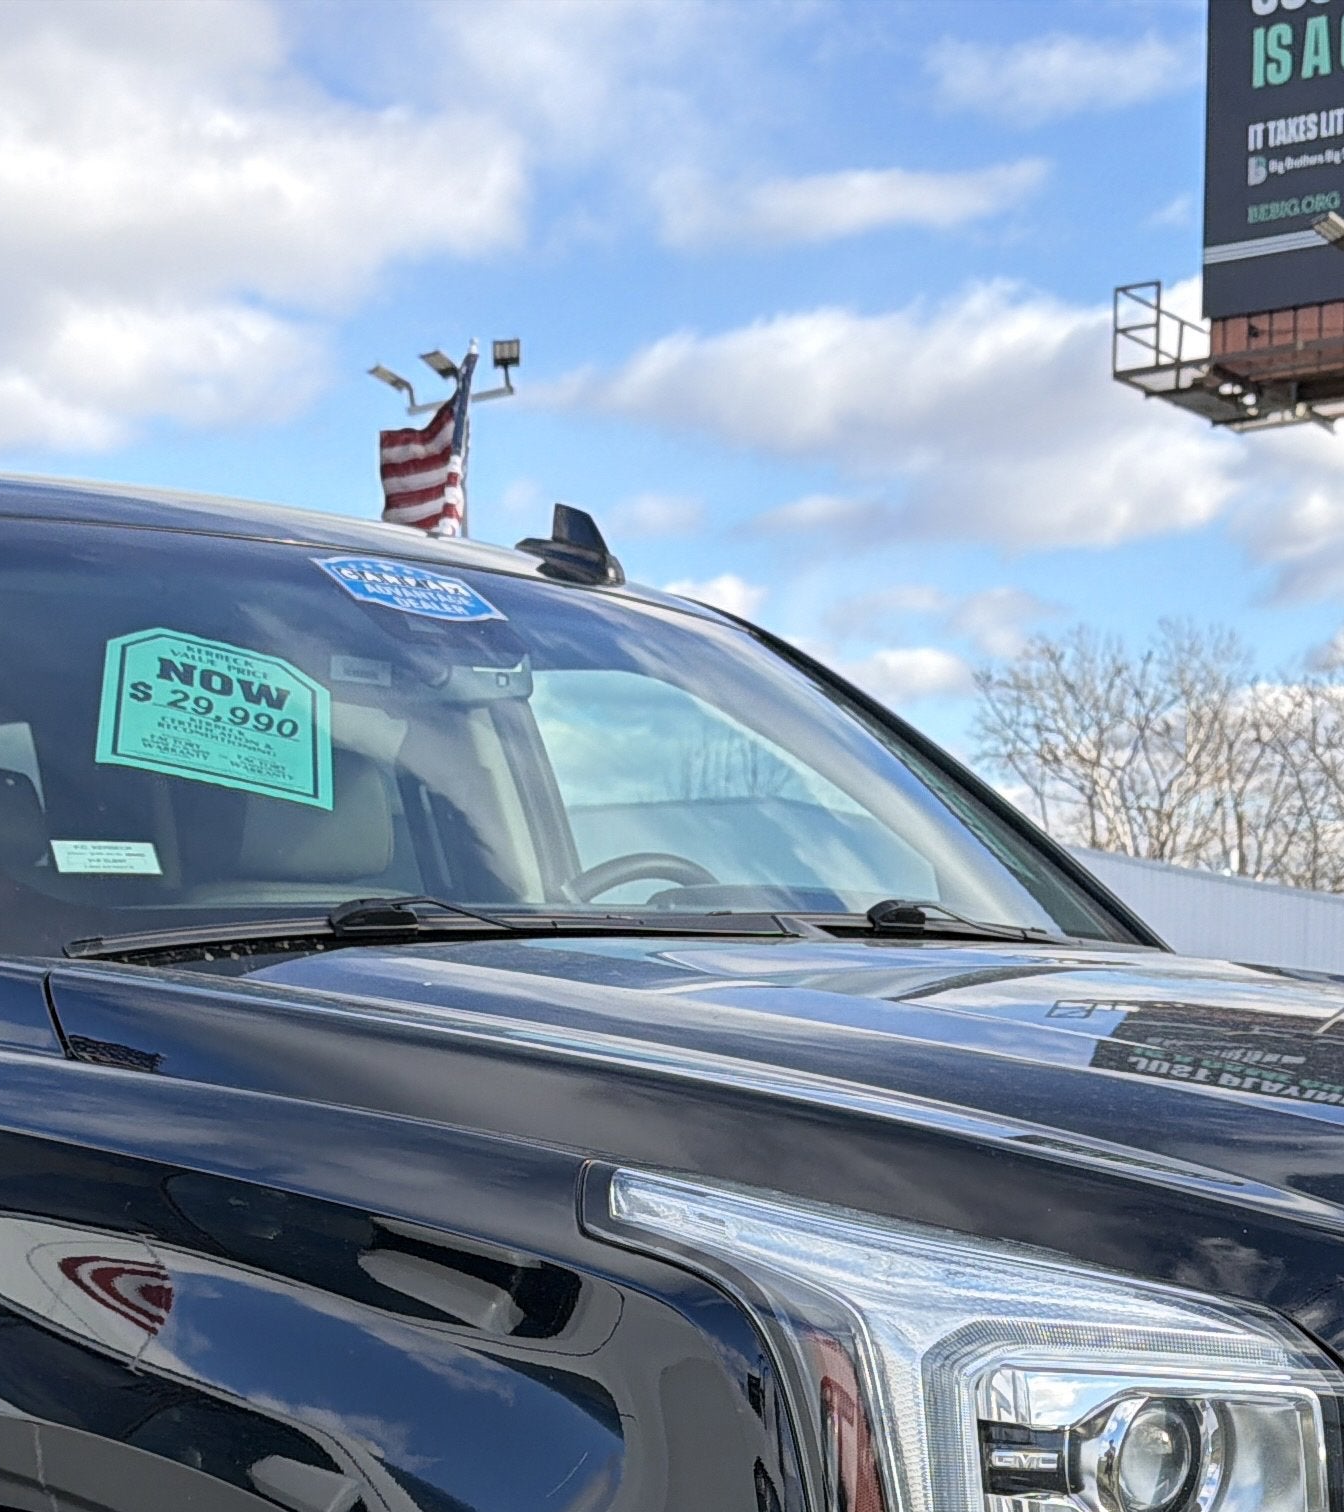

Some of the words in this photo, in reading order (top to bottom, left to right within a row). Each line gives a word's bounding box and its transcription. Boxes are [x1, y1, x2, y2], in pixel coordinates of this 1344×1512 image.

[1252, 22, 1293, 88] IS
[1301, 14, 1332, 79] A
[1248, 122, 1265, 152] IT
[1266, 113, 1318, 147] TAKES
[156, 656, 291, 711] NOW
[170, 649, 218, 668] VALUE
[226, 664, 270, 680] PRICE
[167, 689, 299, 738] 29,990
[991, 1449, 1058, 1472] GMC
